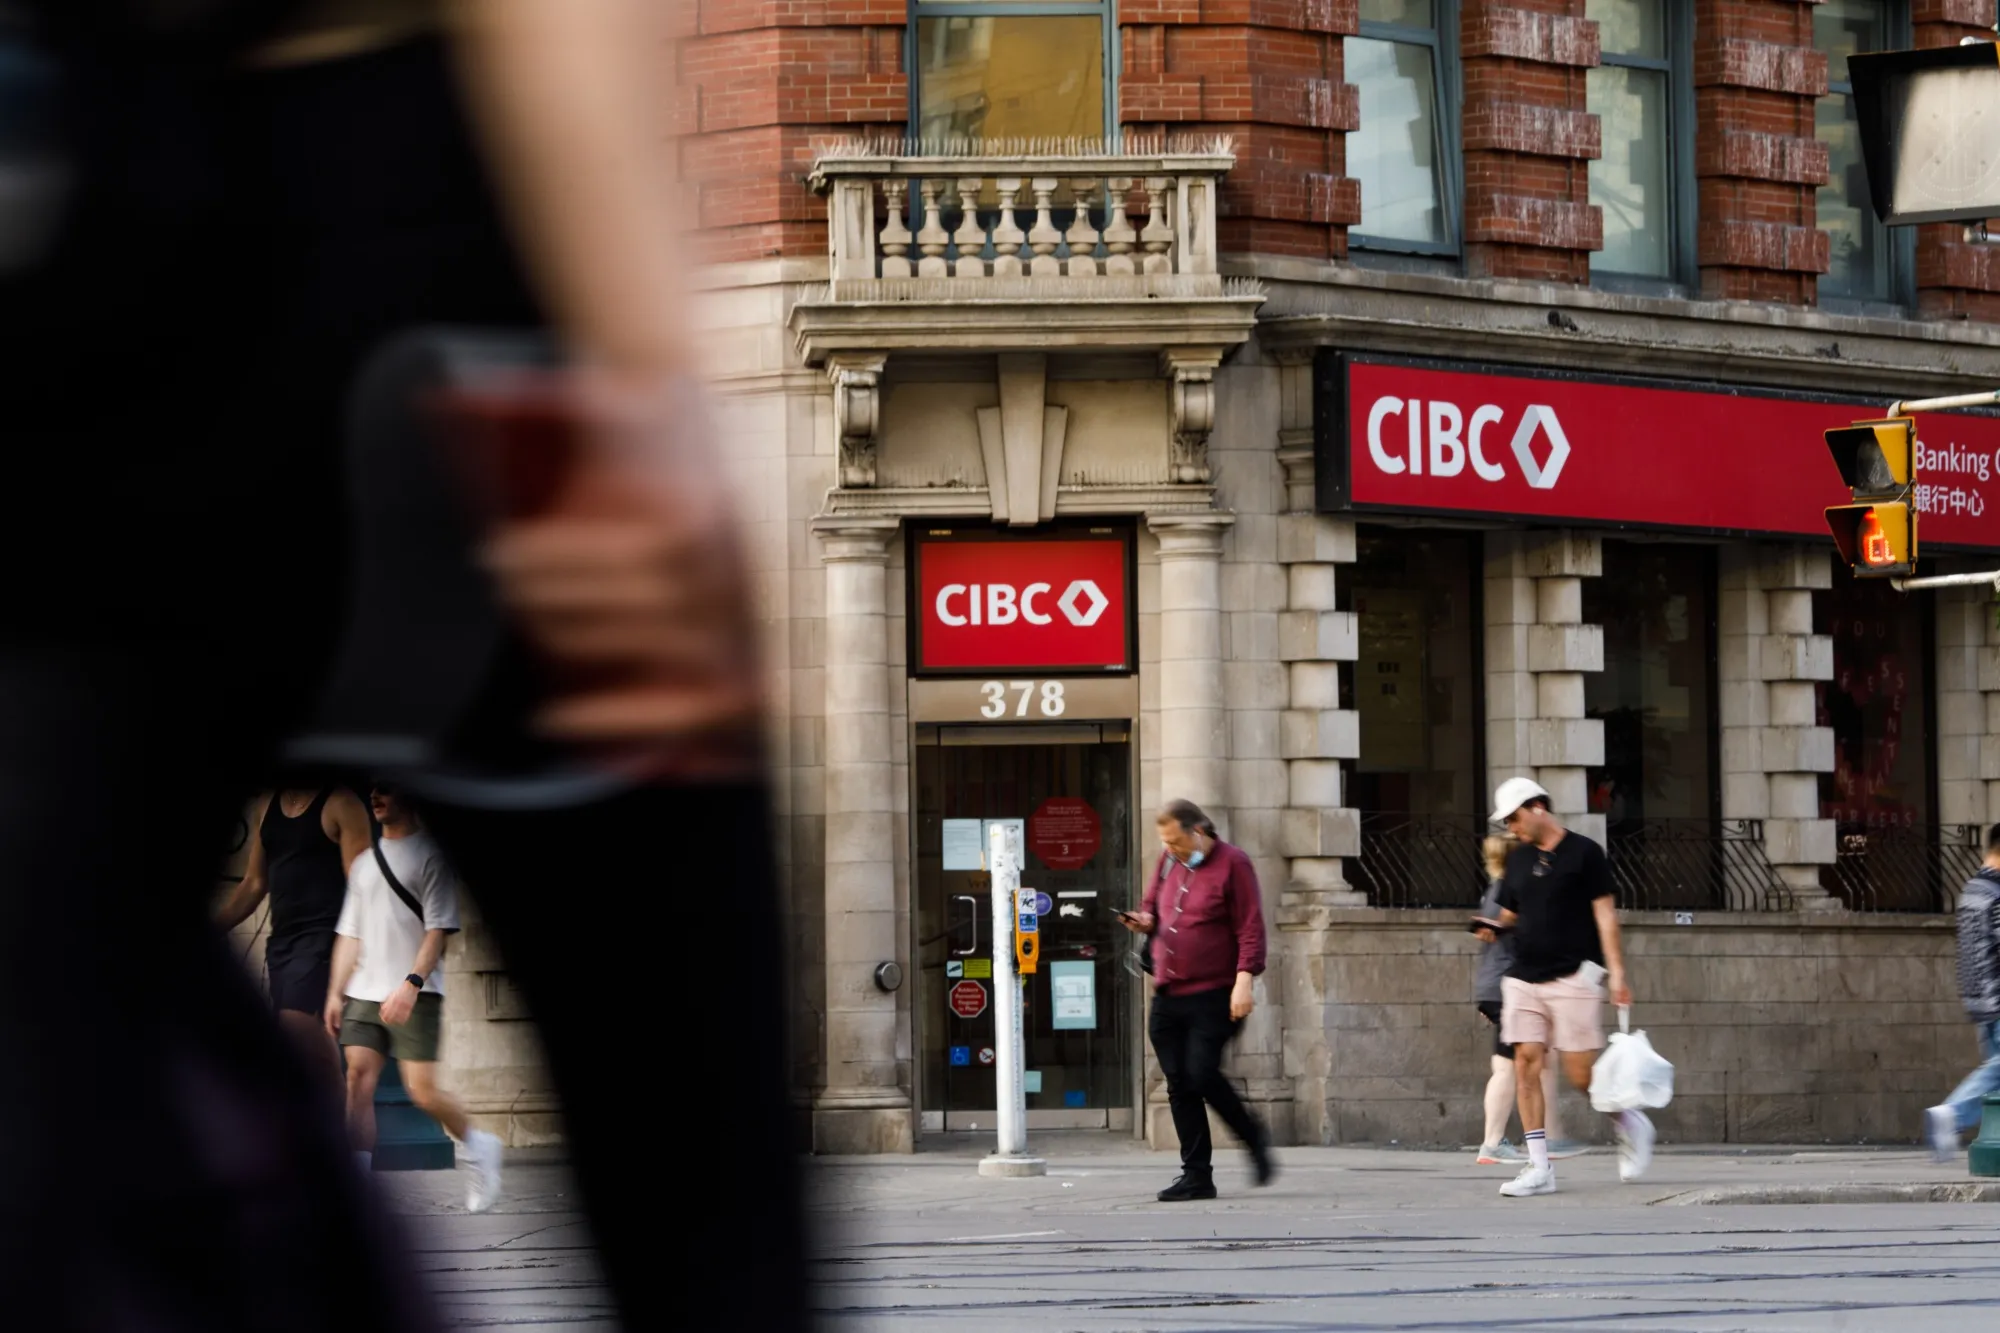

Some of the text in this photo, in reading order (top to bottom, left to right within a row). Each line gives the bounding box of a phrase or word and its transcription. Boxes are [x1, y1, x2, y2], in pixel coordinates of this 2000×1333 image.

[1366, 395, 1506, 482] CIBC
[1915, 440, 1991, 481] Banking
[1914, 484, 1985, 518] 銀行中心
[935, 581, 1053, 627] CIBC
[979, 680, 1066, 718] 378
[1820, 804, 1913, 828] ORKERS
[1061, 844, 1070, 856] 3
